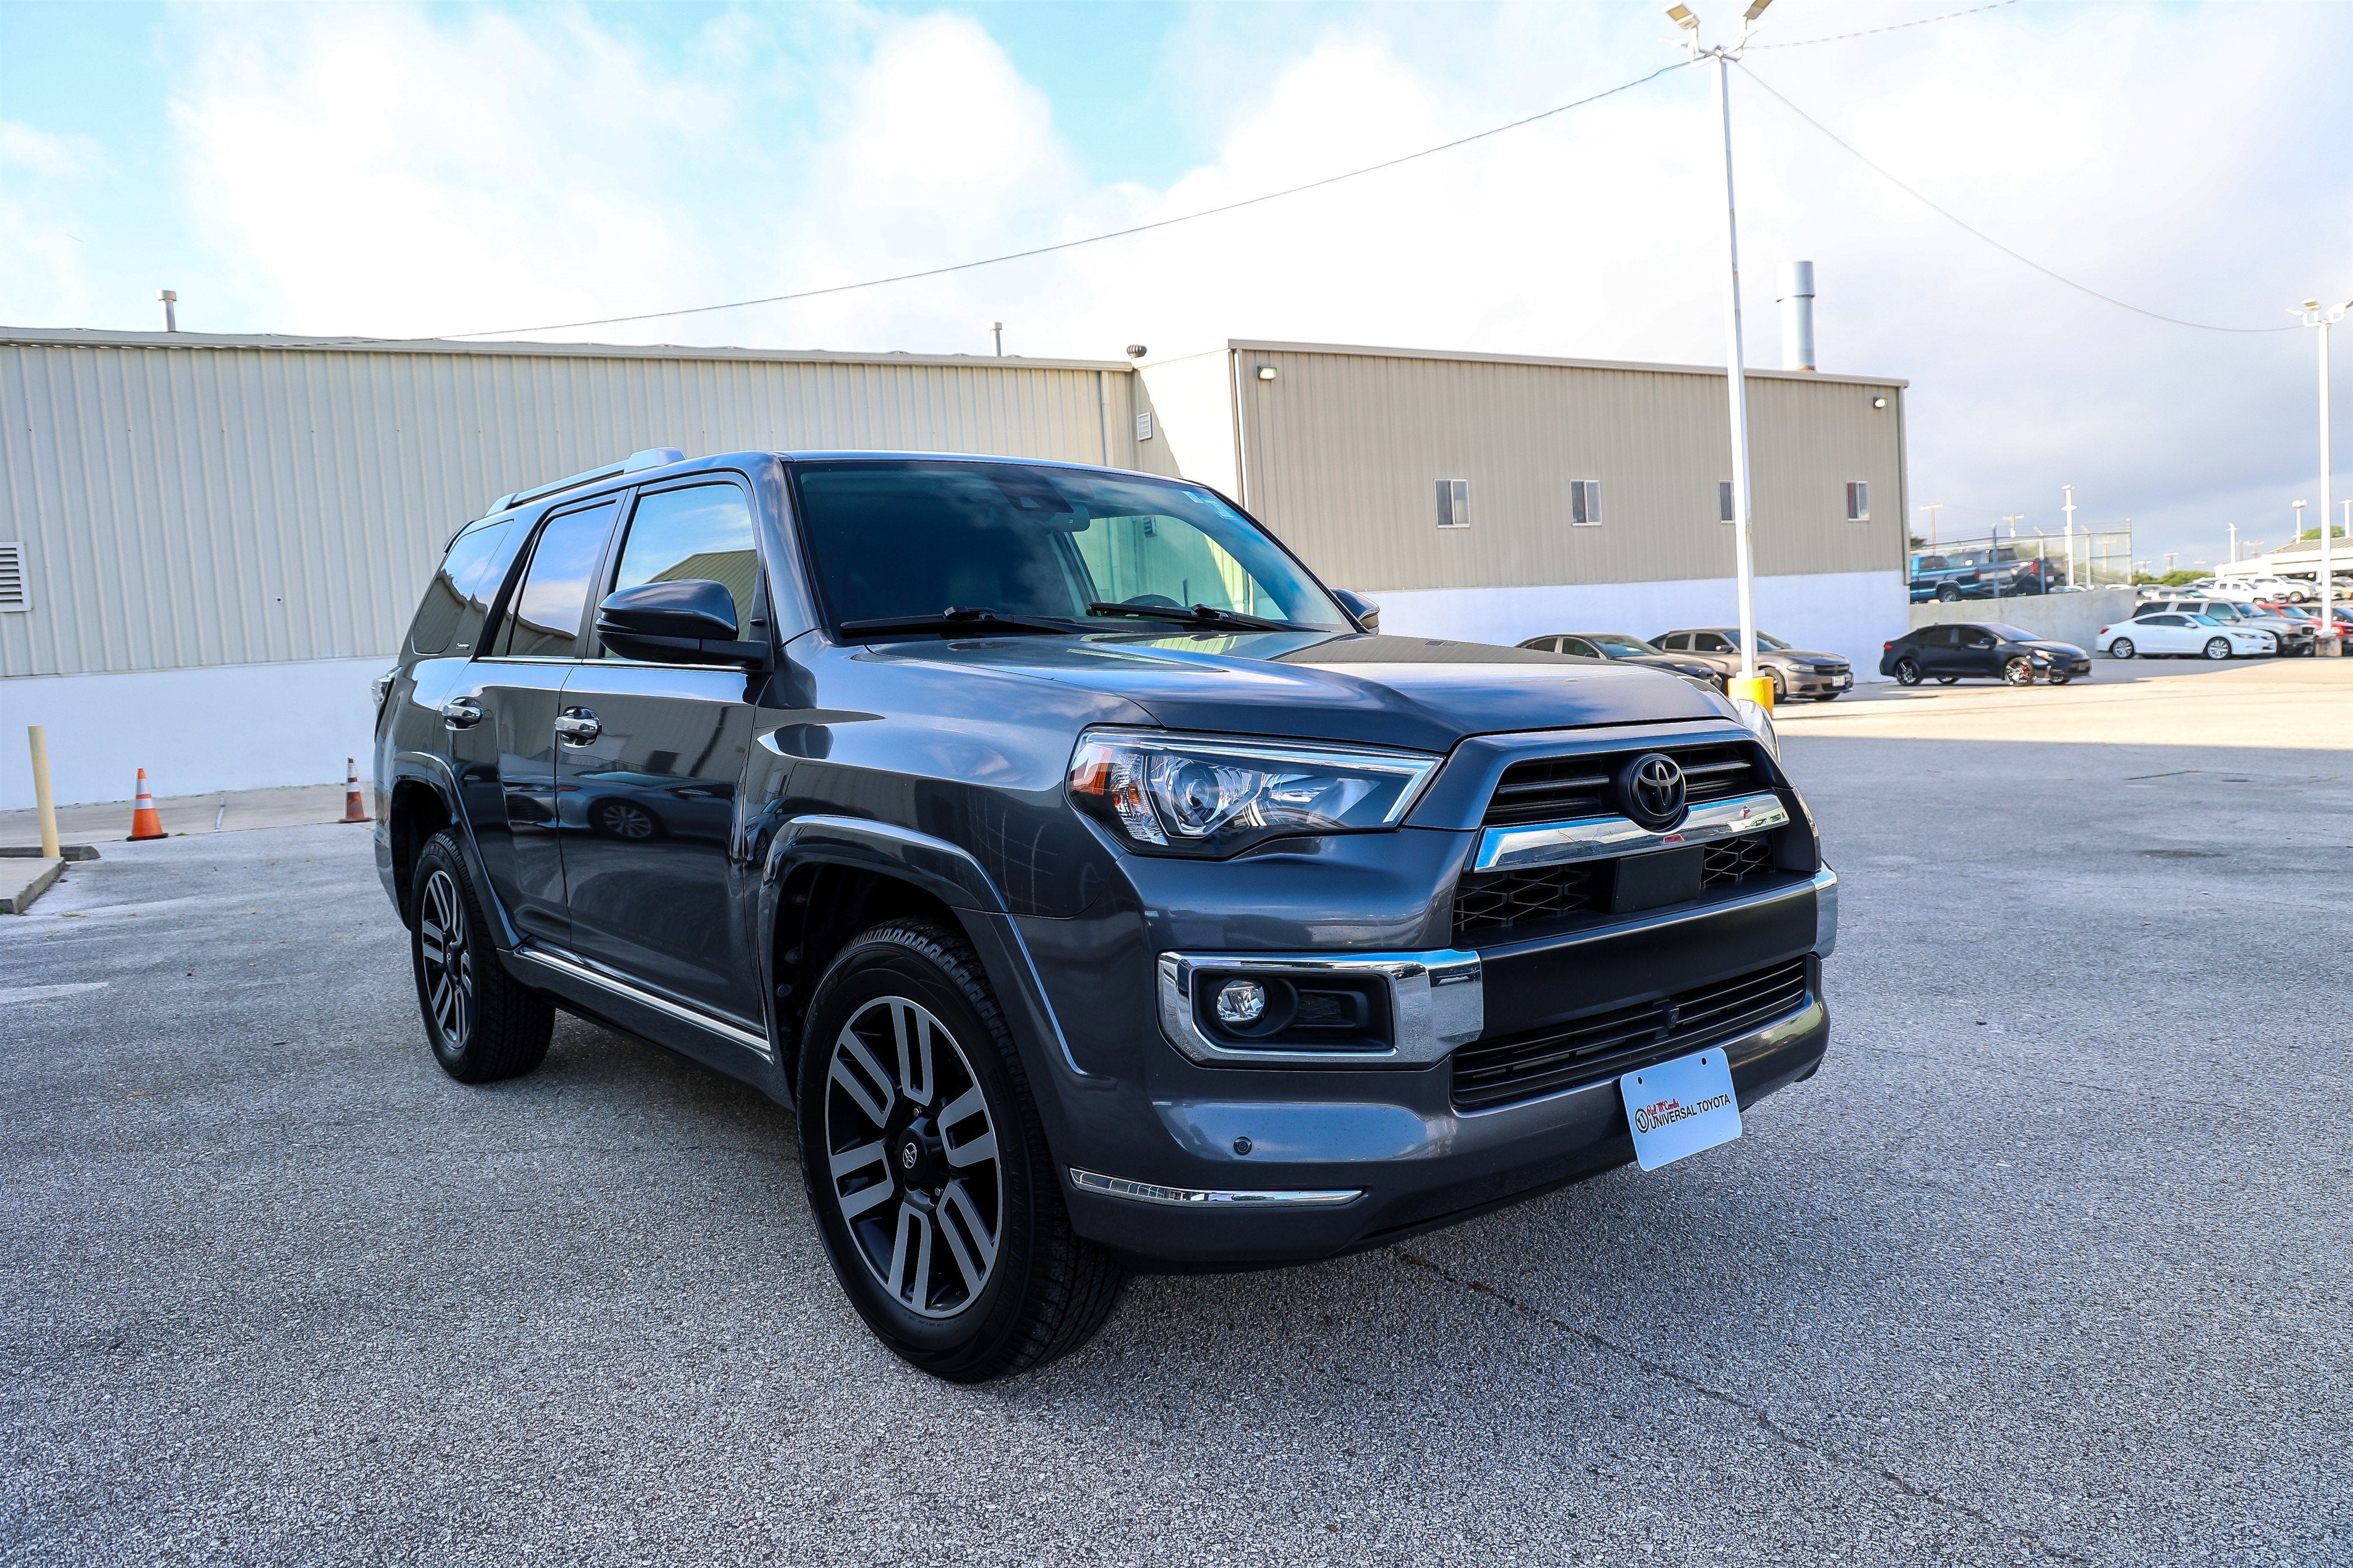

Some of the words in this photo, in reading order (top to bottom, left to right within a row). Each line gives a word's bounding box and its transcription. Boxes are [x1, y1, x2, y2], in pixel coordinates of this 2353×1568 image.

[1647, 1104, 1657, 1117] Red
[1649, 1104, 1697, 1129] UNIVERSAL
[1696, 1094, 1731, 1113] TOYOTA
